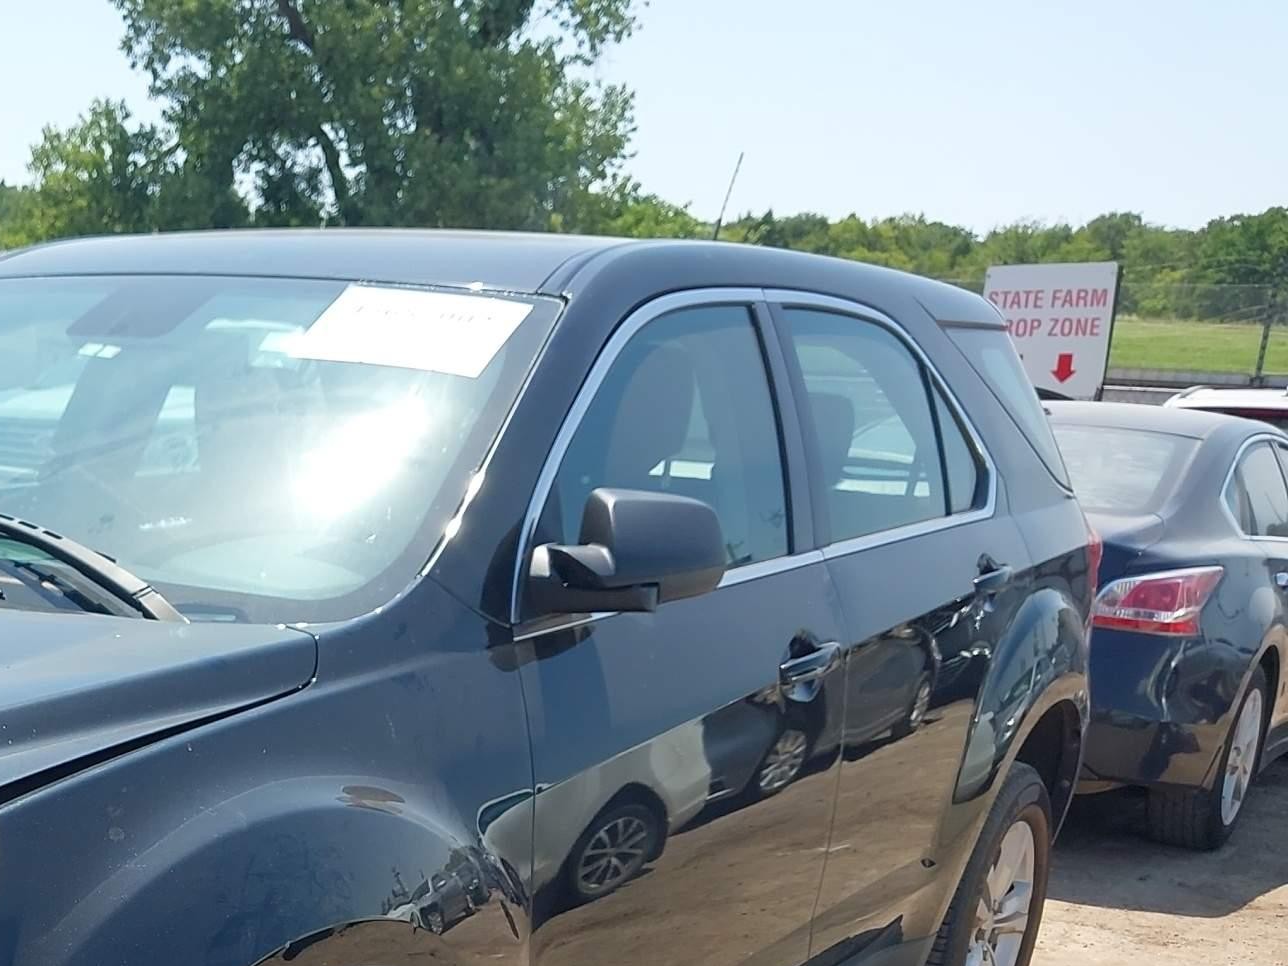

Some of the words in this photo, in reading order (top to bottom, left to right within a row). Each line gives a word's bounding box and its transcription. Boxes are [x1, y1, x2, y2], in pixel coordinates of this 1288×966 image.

[988, 290, 1044, 309] STATE
[1051, 288, 1108, 308] FARM
[1004, 318, 1042, 337] ROP
[1047, 317, 1101, 336] ZONE
